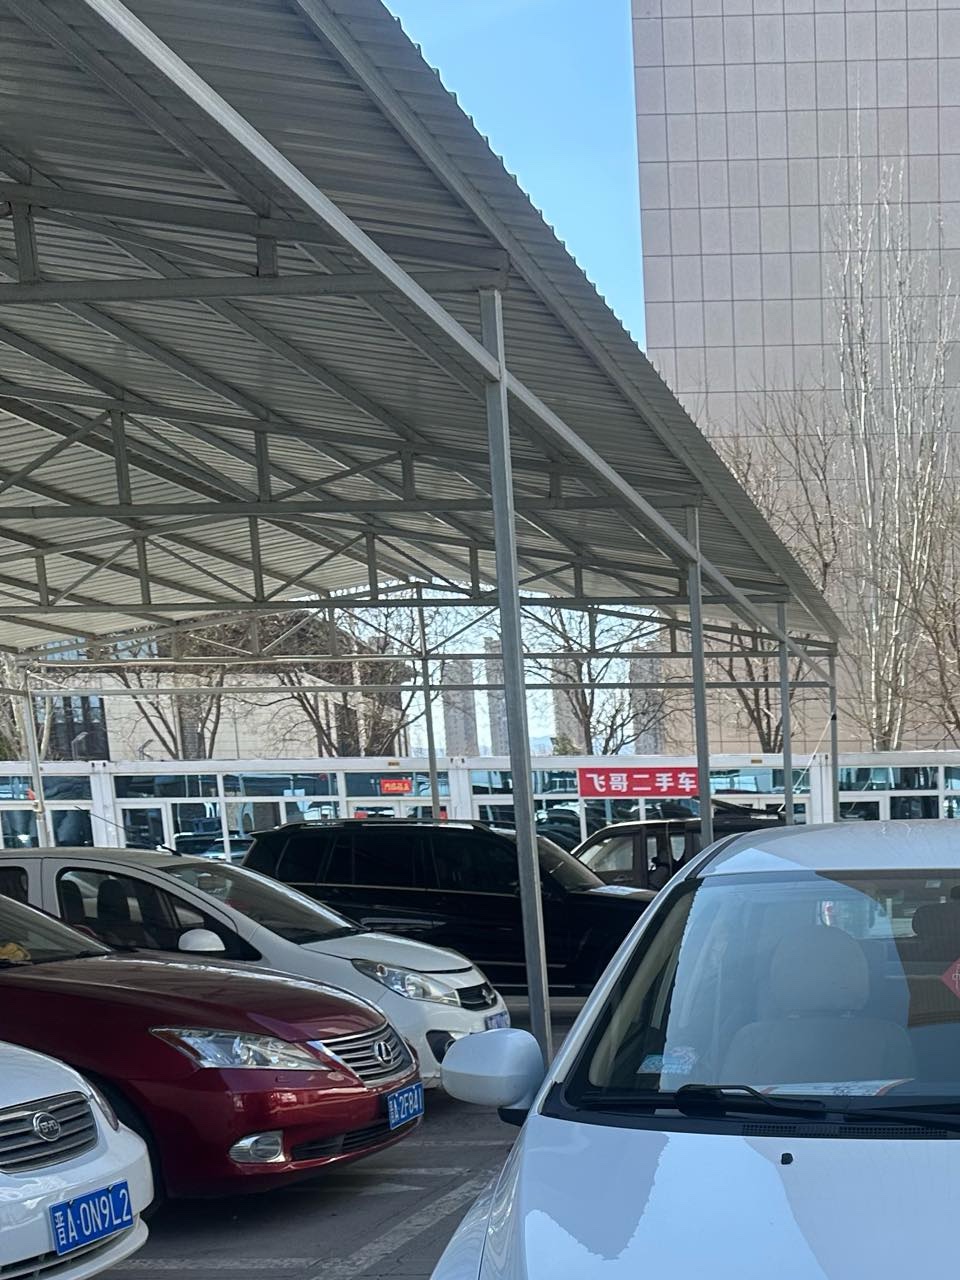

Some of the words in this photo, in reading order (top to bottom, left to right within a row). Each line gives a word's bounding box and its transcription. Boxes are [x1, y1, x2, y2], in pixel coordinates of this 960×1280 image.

[585, 772, 697, 793] 飞哥二手车
[39, 1119, 59, 1133] BYD
